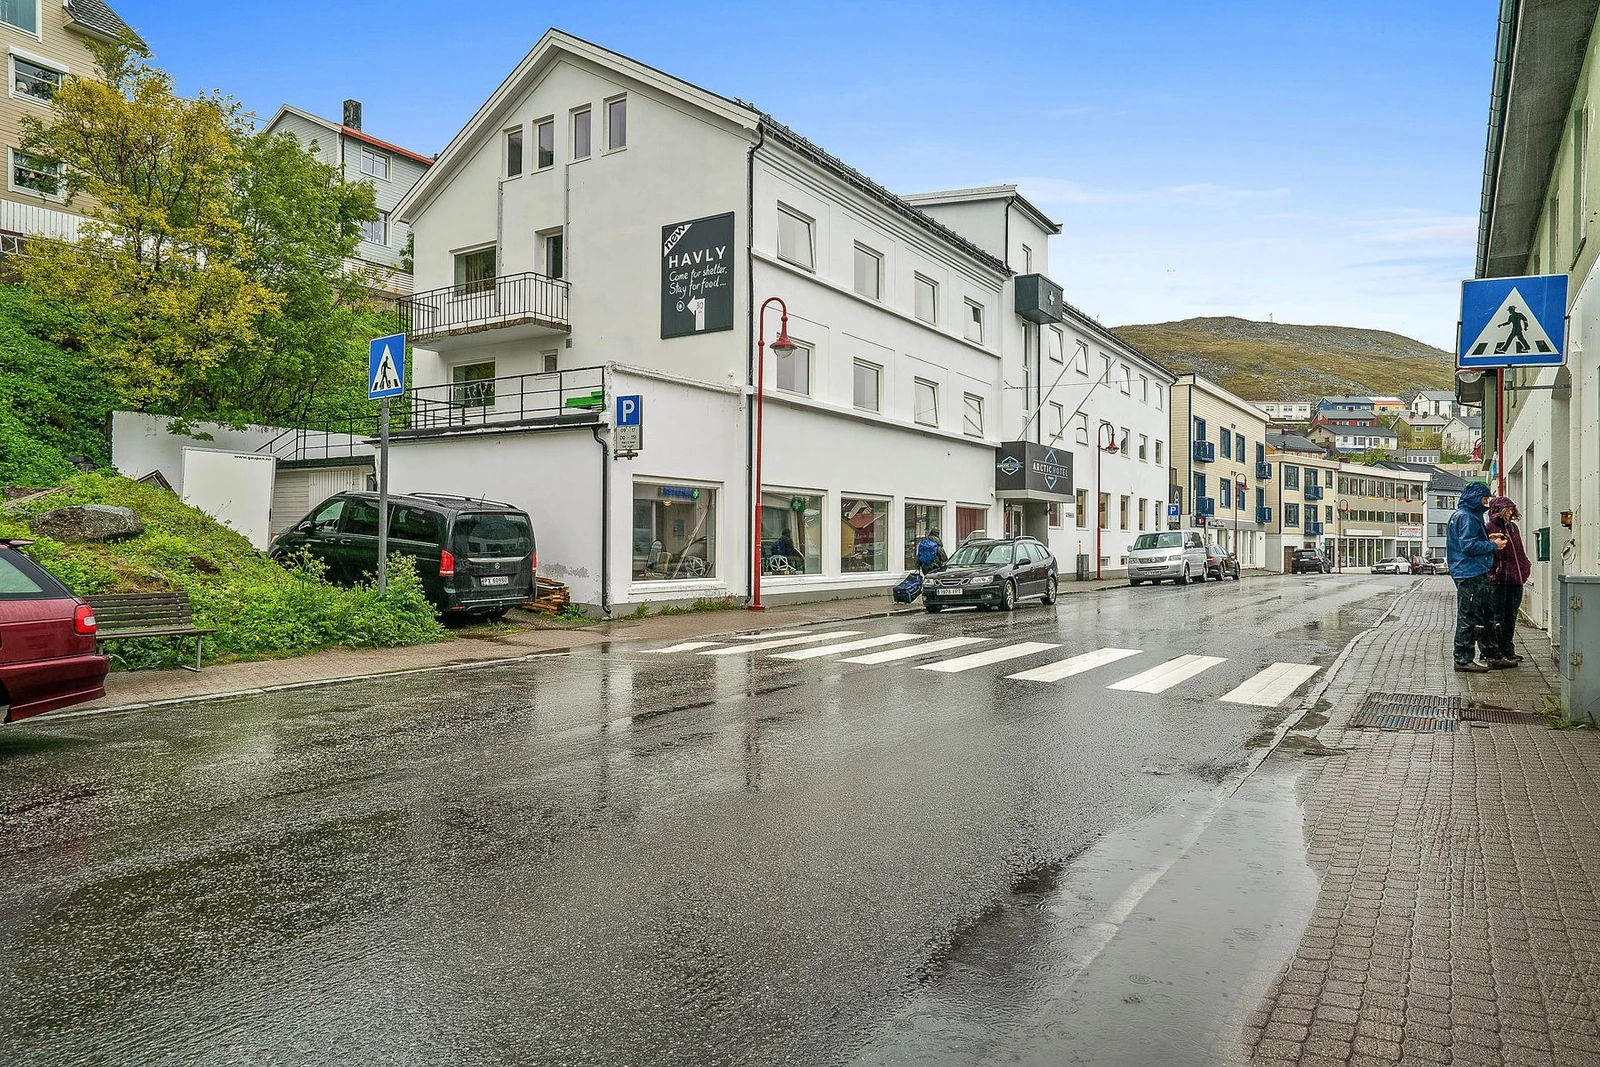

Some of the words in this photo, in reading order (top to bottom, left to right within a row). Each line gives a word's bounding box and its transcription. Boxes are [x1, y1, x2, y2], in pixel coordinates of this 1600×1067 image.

[664, 225, 686, 250] new
[668, 246, 726, 269] HAVLY
[669, 270, 689, 282] Come
[690, 268, 702, 281] for
[669, 282, 687, 299] Stay
[689, 280, 701, 297] for
[622, 400, 635, 423] P
[1032, 462, 1052, 474] ARCTIC
[1053, 466, 1068, 477] HOTEL
[1170, 506, 1176, 514] P
